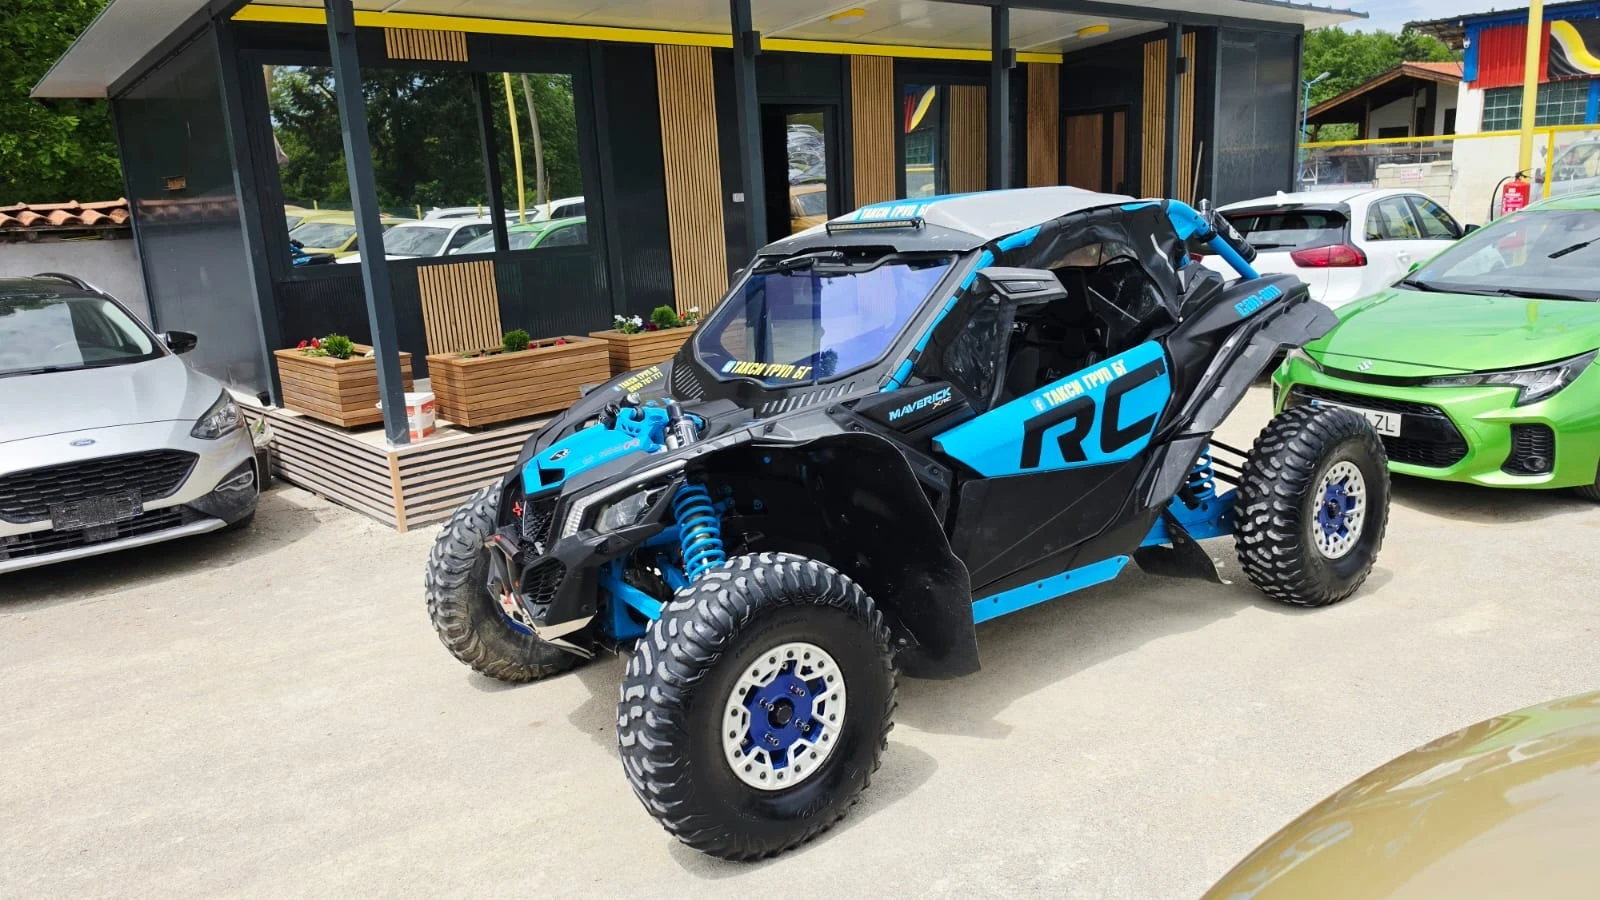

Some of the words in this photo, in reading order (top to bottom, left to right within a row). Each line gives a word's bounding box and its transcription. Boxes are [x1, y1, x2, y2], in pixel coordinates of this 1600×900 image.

[731, 360, 767, 376] ТАКСИ
[763, 363, 795, 378] ГРУП
[791, 365, 812, 380] БГ
[1042, 379, 1085, 407] ТАКСИ
[1081, 366, 1114, 391] ГРУП
[1110, 359, 1128, 377] БГ
[888, 386, 952, 422] MAVERICK
[1020, 356, 1166, 469] RC
